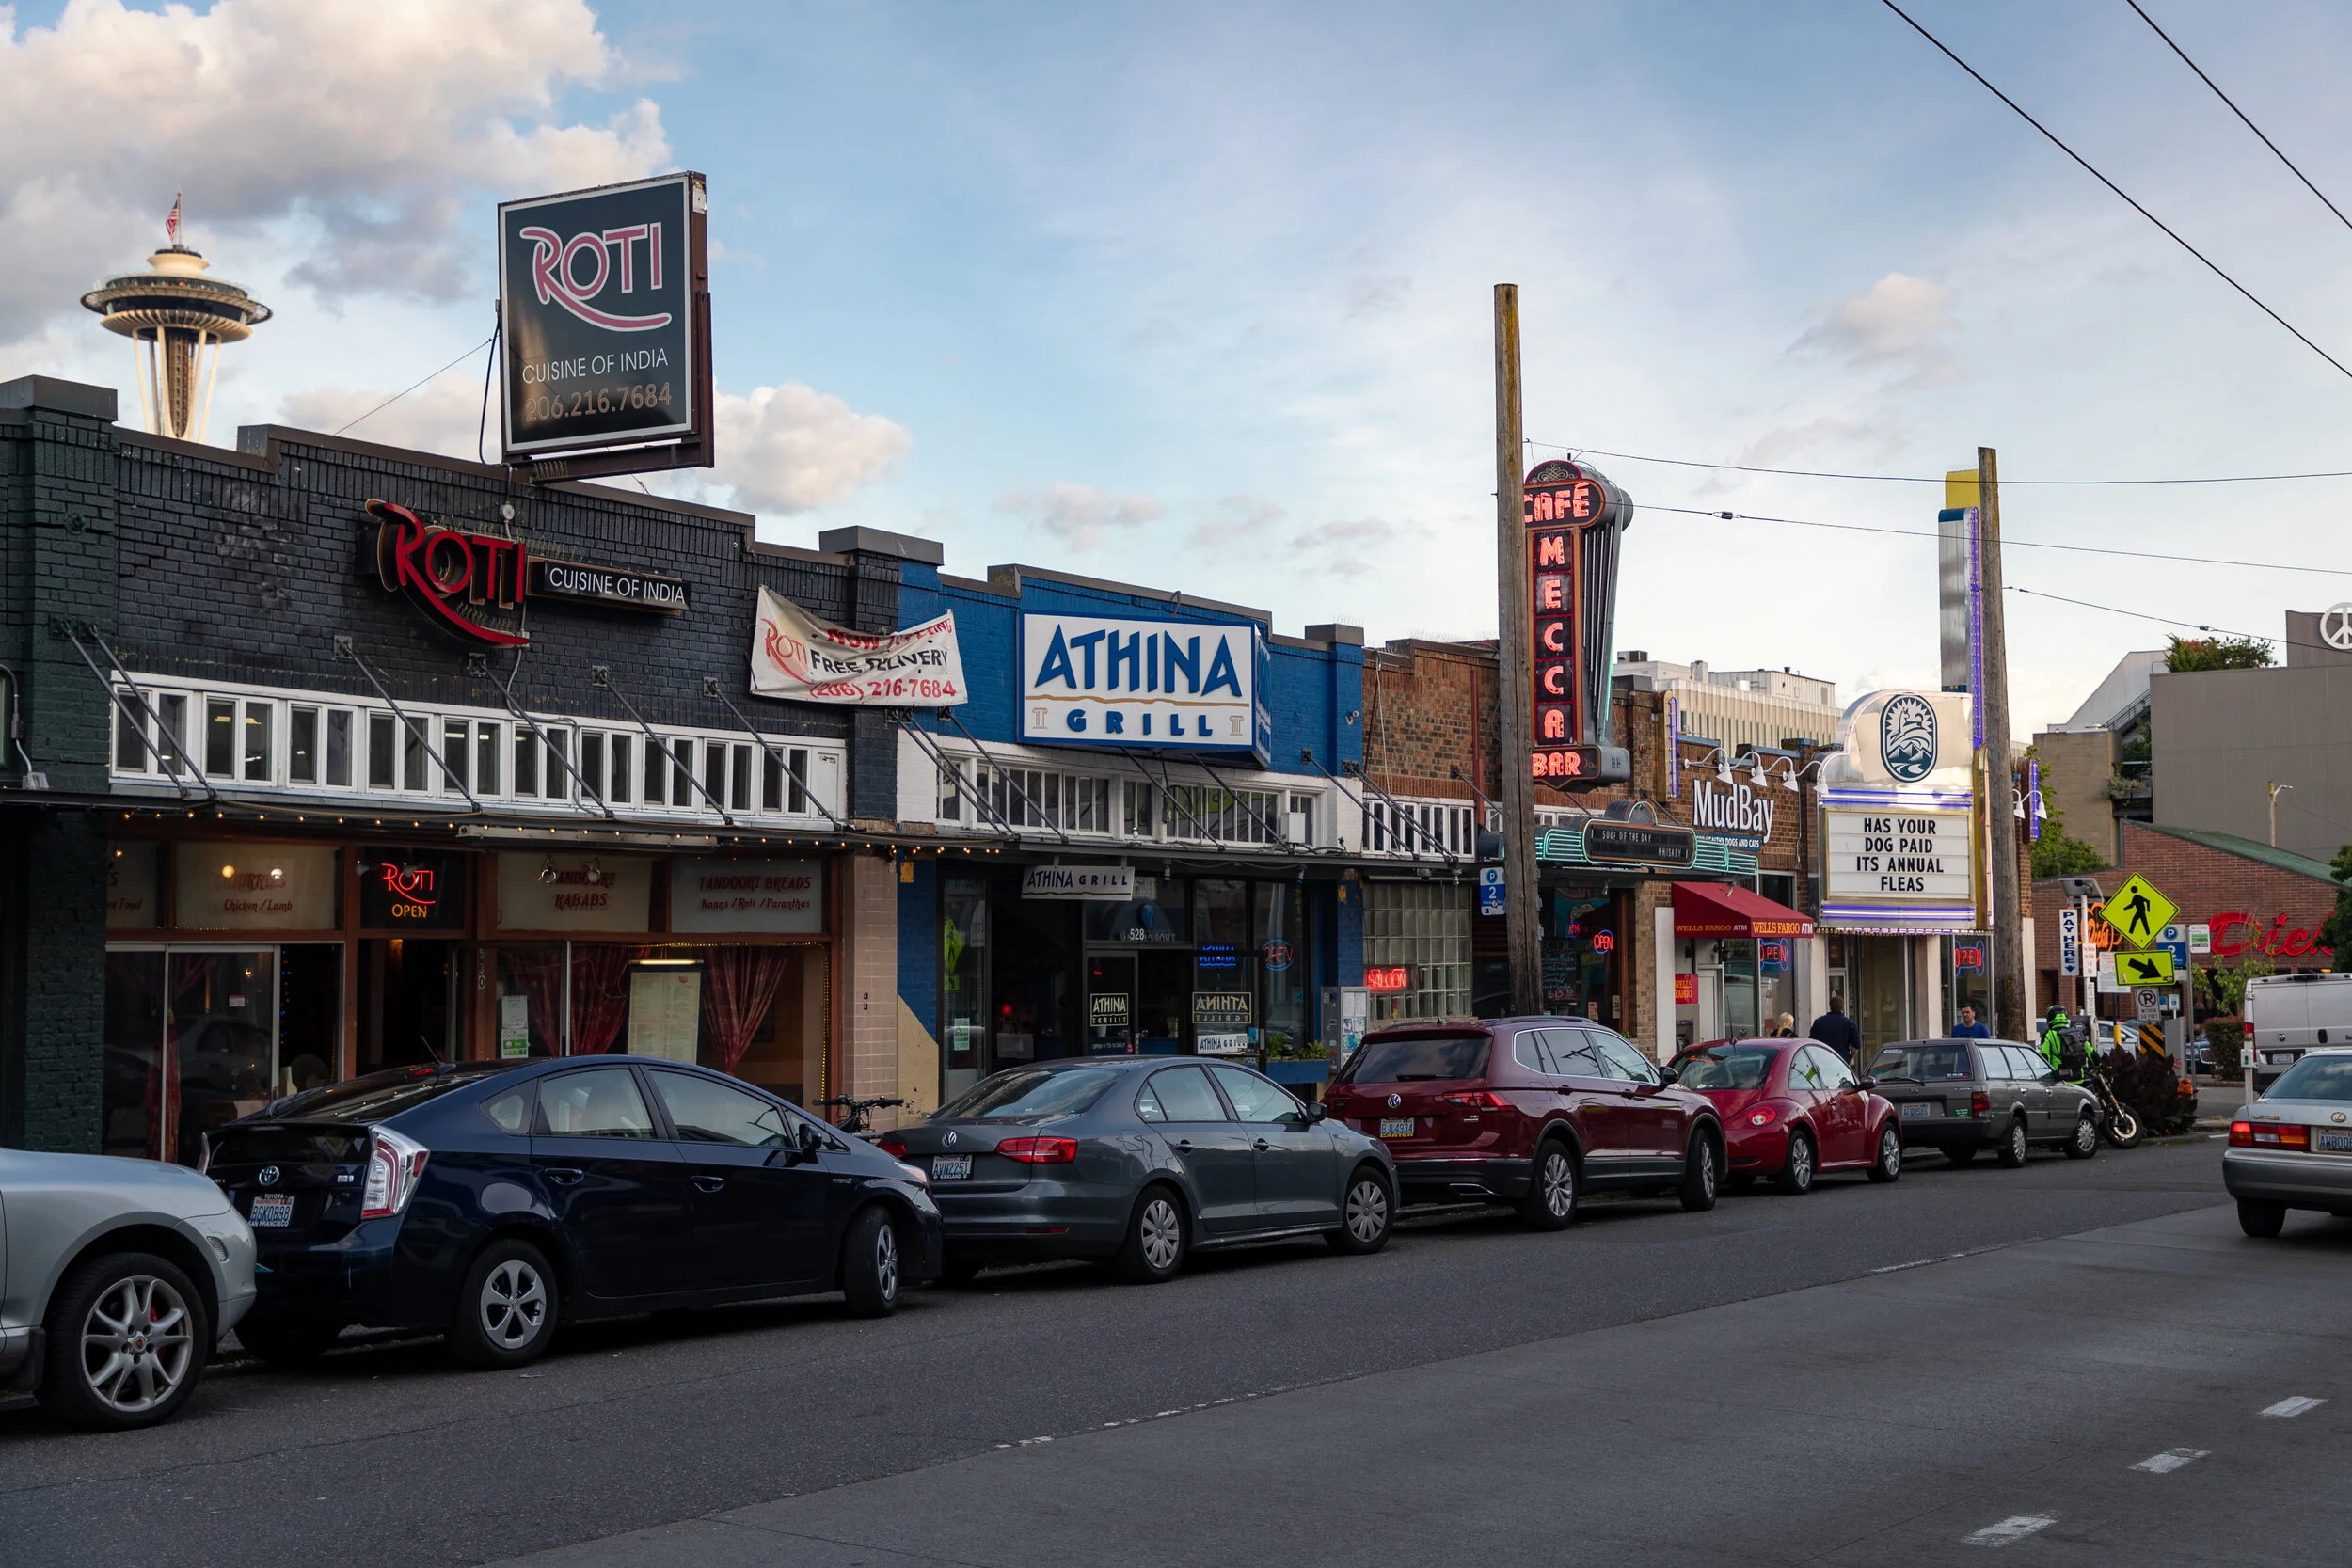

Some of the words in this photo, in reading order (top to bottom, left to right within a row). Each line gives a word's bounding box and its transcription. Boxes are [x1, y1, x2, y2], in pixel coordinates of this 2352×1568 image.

[519, 221, 672, 332] ROTI
[522, 357, 587, 385] CUISINE
[592, 354, 614, 374] OF
[621, 347, 669, 371] INDIA
[525, 381, 672, 422] 206.216.7684
[365, 499, 531, 647] ROTI
[549, 567, 612, 594] CUISINE
[617, 577, 640, 597] OF
[644, 580, 686, 605] INDIA
[1539, 536, 1565, 739] MECCA
[761, 618, 817, 685] ROTI
[1035, 623, 1242, 697] ATHINA
[810, 648, 862, 673] FREE
[809, 681, 865, 700] (206)
[867, 677, 956, 698] 216-7684
[1066, 708, 1213, 736] GRILL
[1531, 752, 1581, 777] BAR
[1693, 779, 1774, 844] MudBay
[1864, 817, 1891, 833] HAS
[1898, 819, 1936, 834] YOUR
[1629, 832, 1639, 842] THE
[1725, 838, 1738, 847] DOGS
[1866, 837, 1893, 852] DOG
[1900, 838, 1932, 853] PAID
[1857, 856, 1879, 871] ITS
[1887, 857, 1944, 873] ANNUAL
[381, 863, 436, 905] ROTI
[699, 876, 760, 892] TANDOORI
[765, 876, 811, 892] BREADS
[1026, 870, 1073, 888] ATHINA
[1079, 875, 1127, 886] GRILL
[1882, 876, 1924, 892] FLEAS
[1489, 886, 1497, 899] 2
[224, 898, 258, 912] Chicken
[554, 893, 608, 910] KABABS
[701, 897, 729, 910] Naans
[391, 904, 427, 918] OPEN
[1568, 924, 1580, 934] ATM
[1753, 922, 1777, 933] WELLS
[1778, 922, 1800, 934] FARGO
[1802, 923, 1814, 934] ATM
[2063, 911, 2075, 932] PAY
[1130, 928, 1144, 941] 528
[1594, 934, 1613, 950] OPEN
[1955, 947, 1982, 968] OPEN
[2063, 935, 2075, 963] HERE
[1368, 971, 1406, 989] SALOON
[1675, 990, 1692, 998] FARGO
[1093, 997, 1126, 1013] ATHINA
[1200, 1037, 1221, 1051] ATHINA
[933, 1162, 968, 1175] AVN2251
